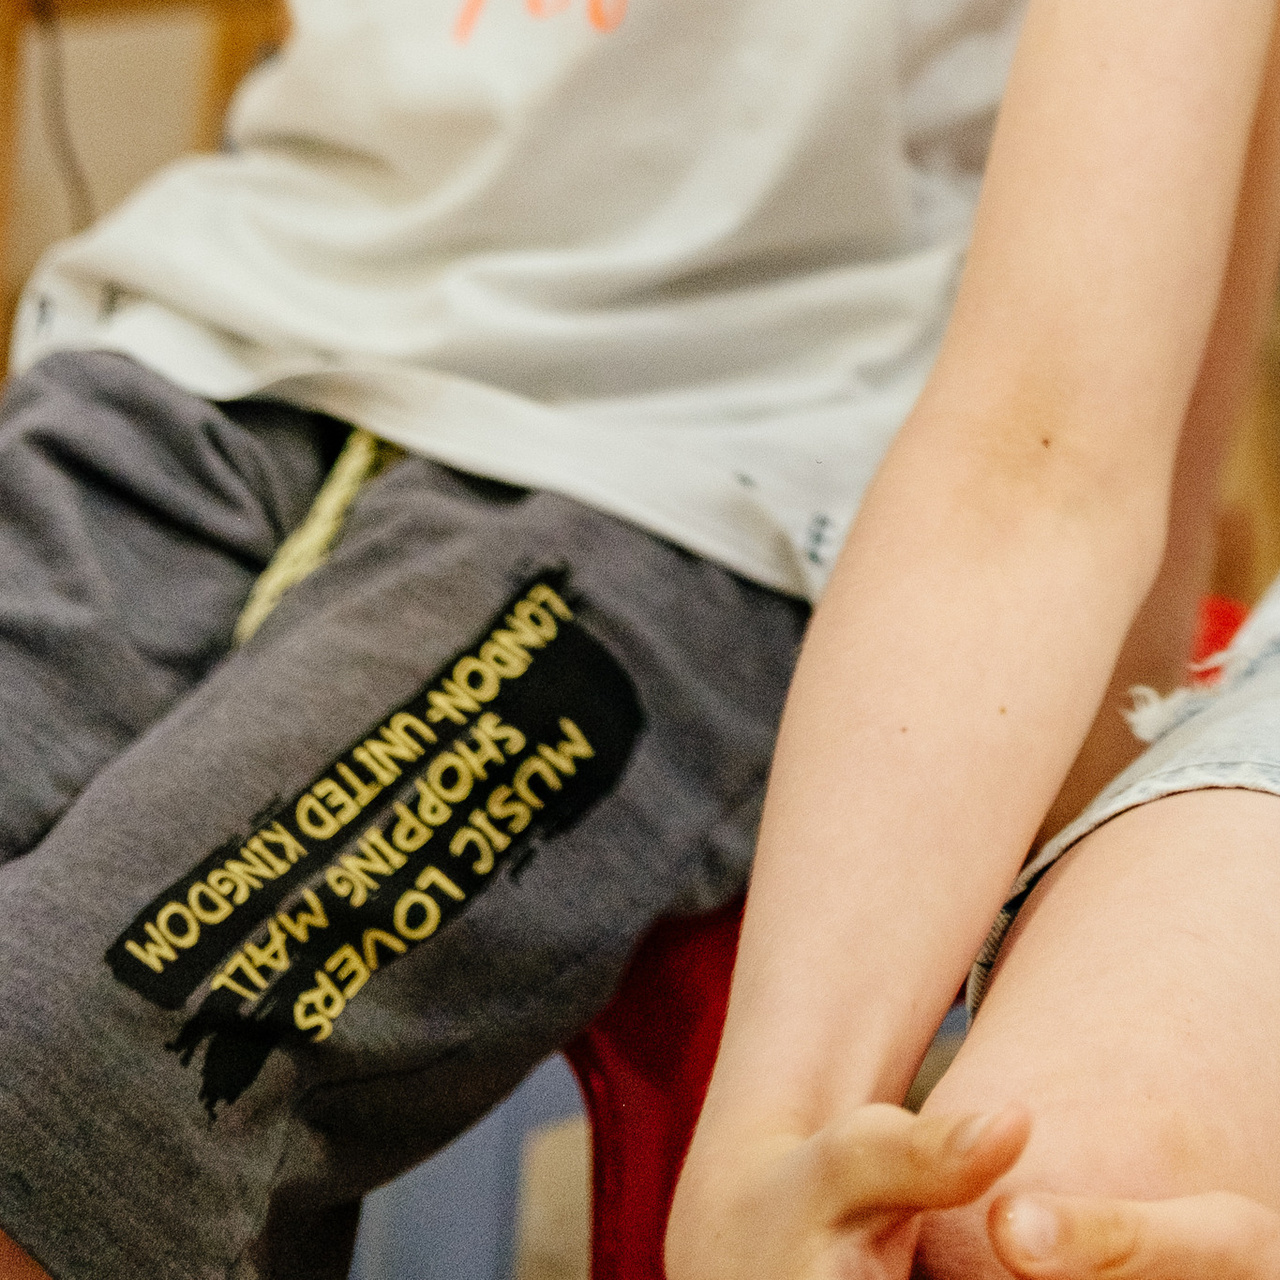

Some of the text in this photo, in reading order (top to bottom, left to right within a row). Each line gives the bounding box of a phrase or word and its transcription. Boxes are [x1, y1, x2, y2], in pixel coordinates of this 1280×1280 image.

[123, 818, 310, 975] KINGDOM
[210, 711, 527, 1003] SHOPPING MALL
[292, 715, 595, 1044] MUSIC LOVERS
